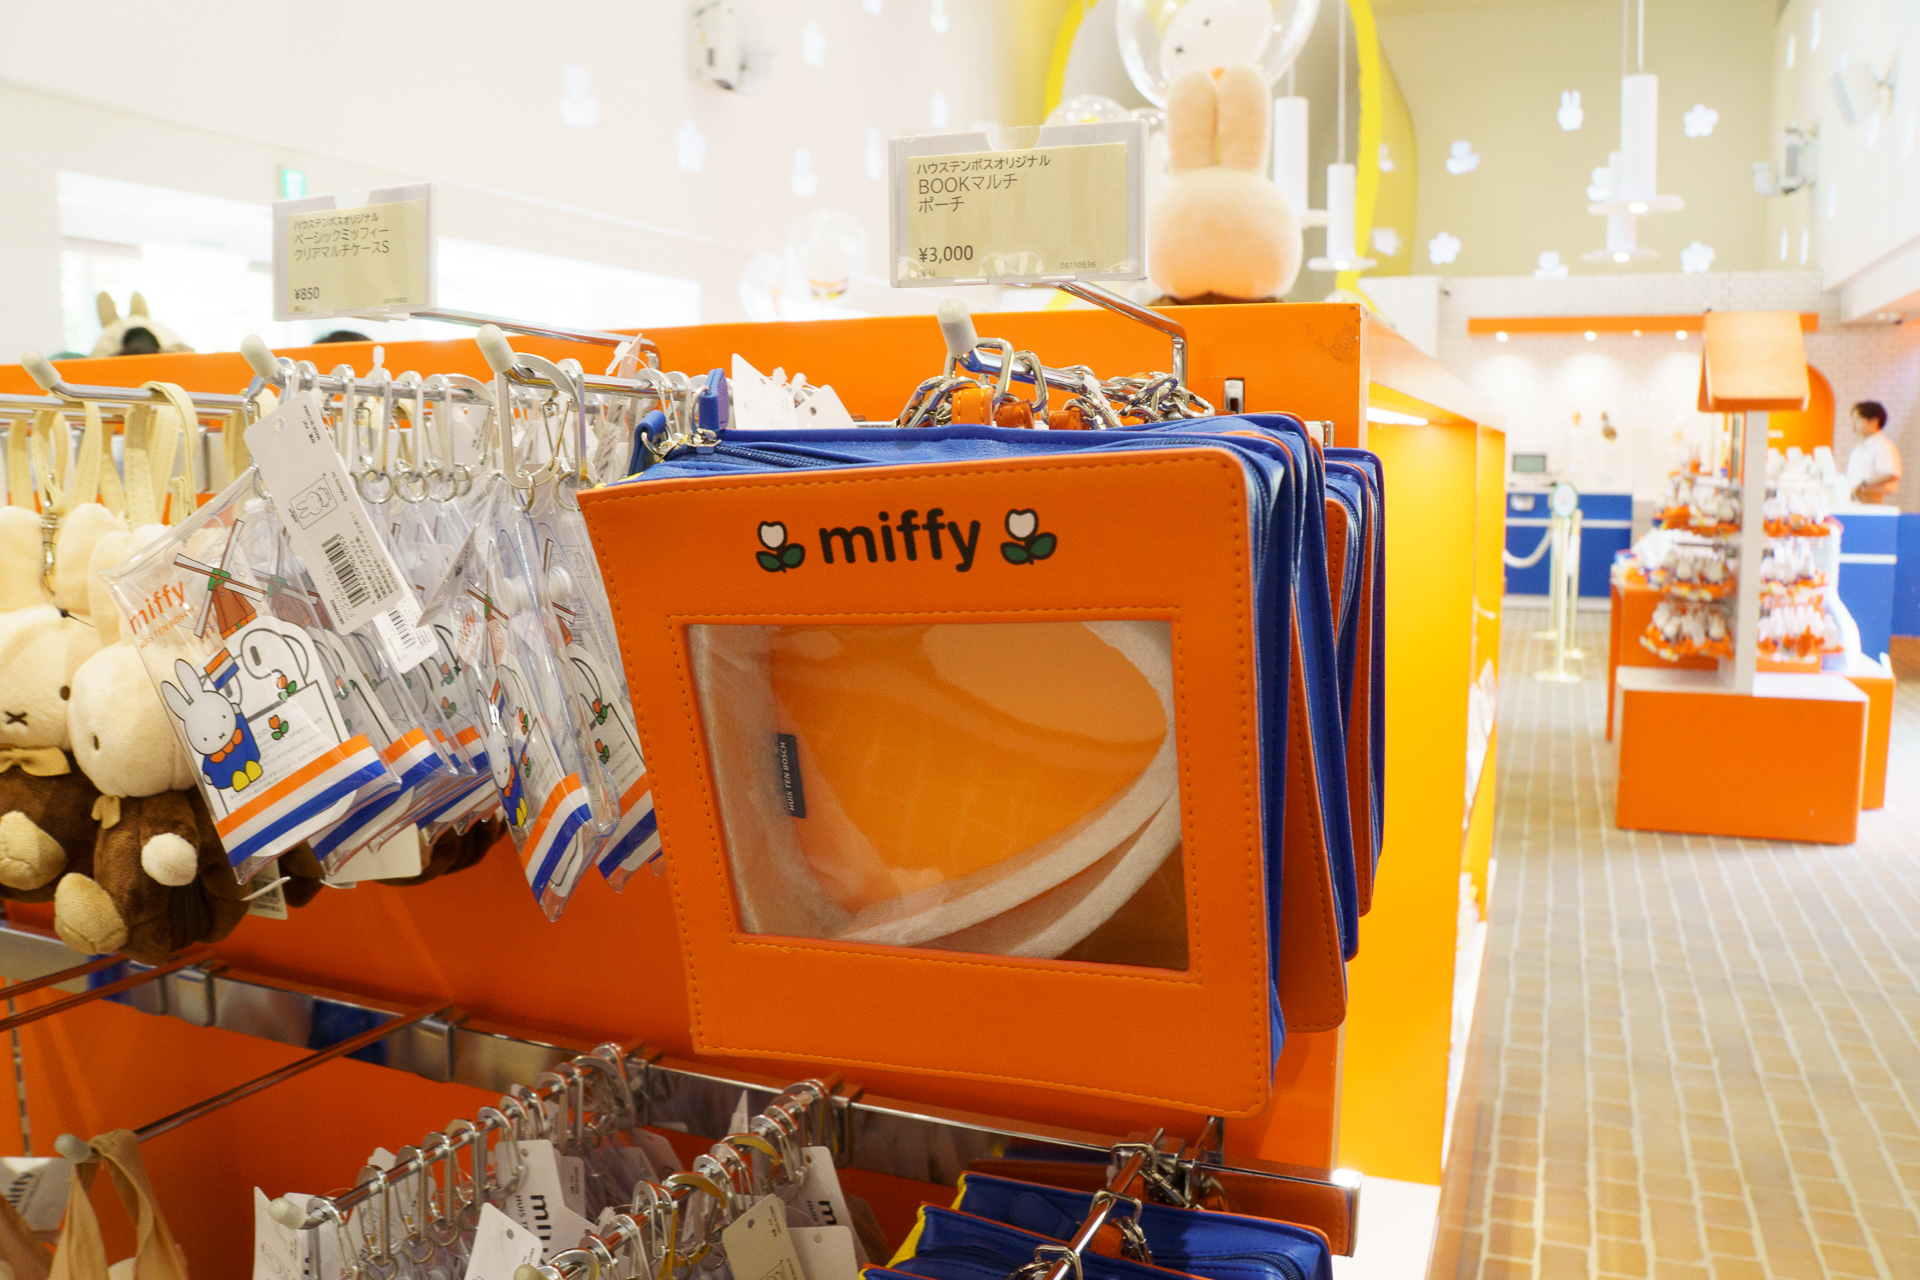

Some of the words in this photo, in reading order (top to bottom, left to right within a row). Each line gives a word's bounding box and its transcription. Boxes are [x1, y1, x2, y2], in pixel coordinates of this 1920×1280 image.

[917, 155, 1050, 174] ハウステンボスオリジナル
[919, 173, 1018, 194] BOOKマルチ
[919, 196, 964, 213] ポーチ
[294, 213, 379, 230] ハウステンボスオリジナル
[294, 241, 390, 261] クリアマルチケースS
[919, 245, 973, 264] ¥3,000
[294, 287, 320, 301] ¥850
[819, 508, 981, 572] miffy
[129, 581, 185, 635] miffy
[783, 772, 792, 788] TEN
